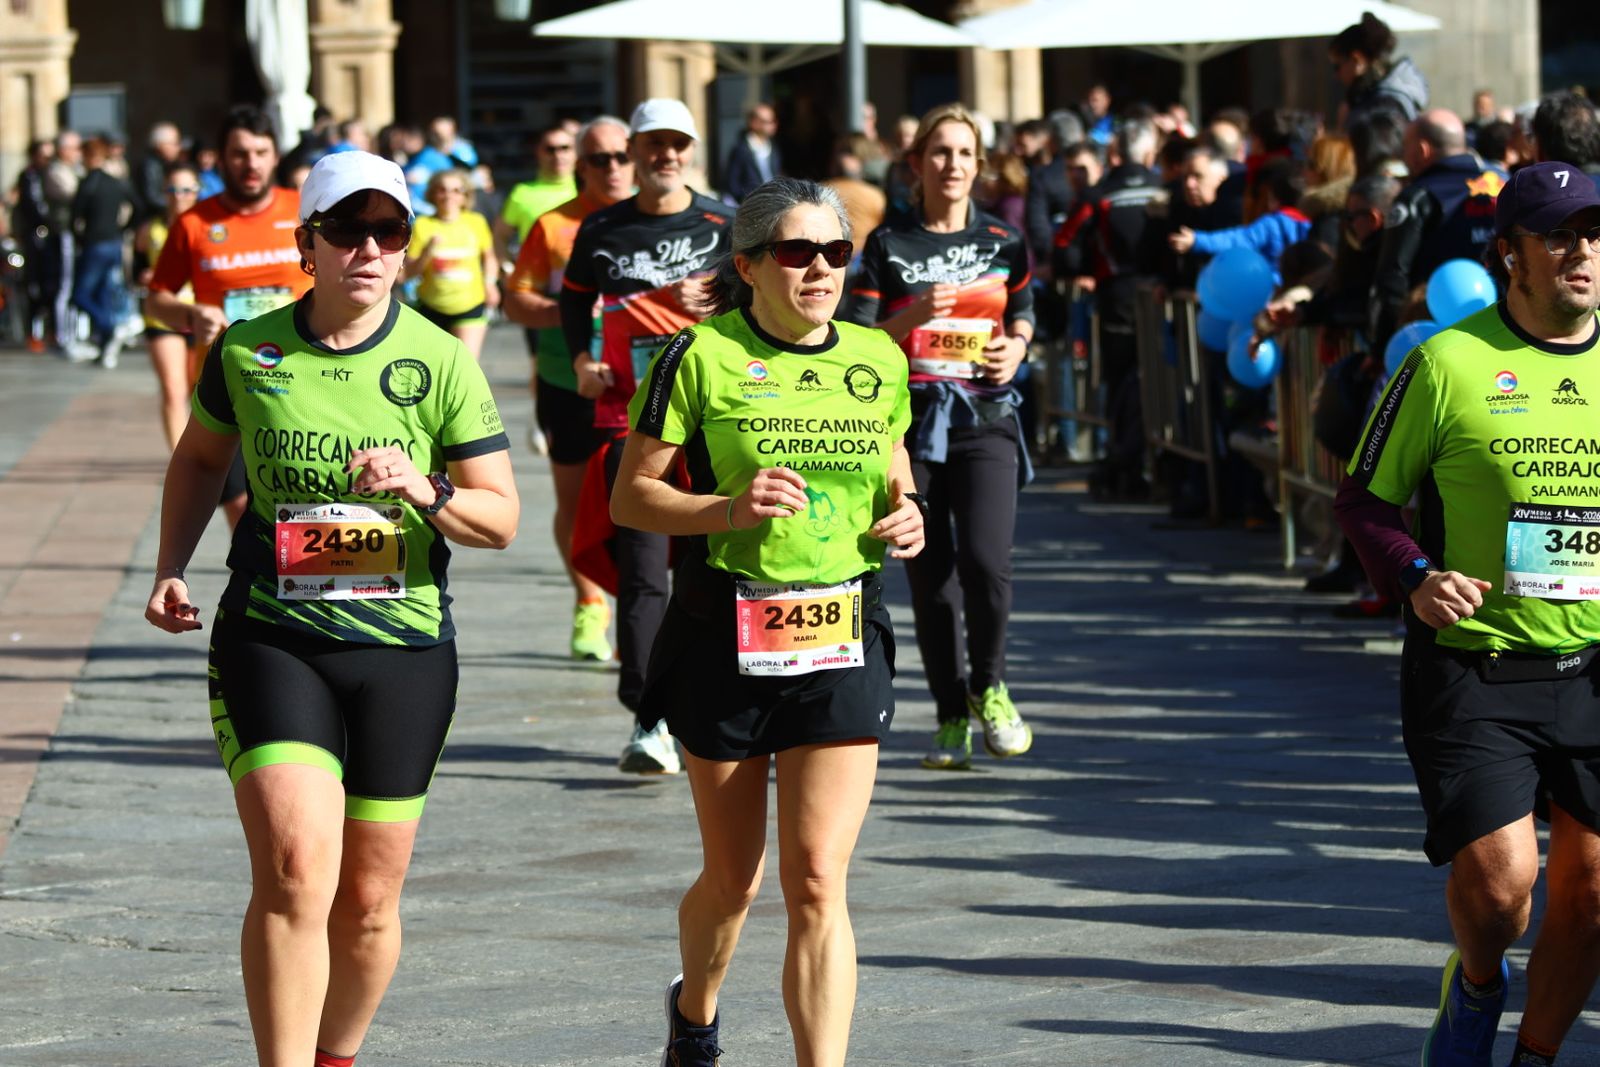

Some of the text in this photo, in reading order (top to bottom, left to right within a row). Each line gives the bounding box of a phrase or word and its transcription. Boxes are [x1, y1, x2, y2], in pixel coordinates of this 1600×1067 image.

[1553, 171, 1570, 188] 7
[201, 248, 301, 272] SALAMANC
[930, 334, 978, 350] 2656
[240, 369, 295, 379] CARBAJOSA
[650, 335, 688, 423] CORRECAMINOS
[1485, 394, 1530, 402] CARBAJOSA
[1363, 368, 1410, 471] CORRECAMINOS
[757, 439, 880, 455] CARBAJOSA
[776, 461, 862, 472] SALAMANCA
[1531, 486, 1600, 497] SALAMAN
[1514, 508, 1530, 519] XIV
[303, 529, 384, 553] 2430
[1544, 529, 1600, 555] 348
[294, 583, 319, 591] BORAL
[1512, 580, 1547, 589] LABORAL
[764, 602, 841, 630] 2438
[1556, 656, 1581, 672] ipso
